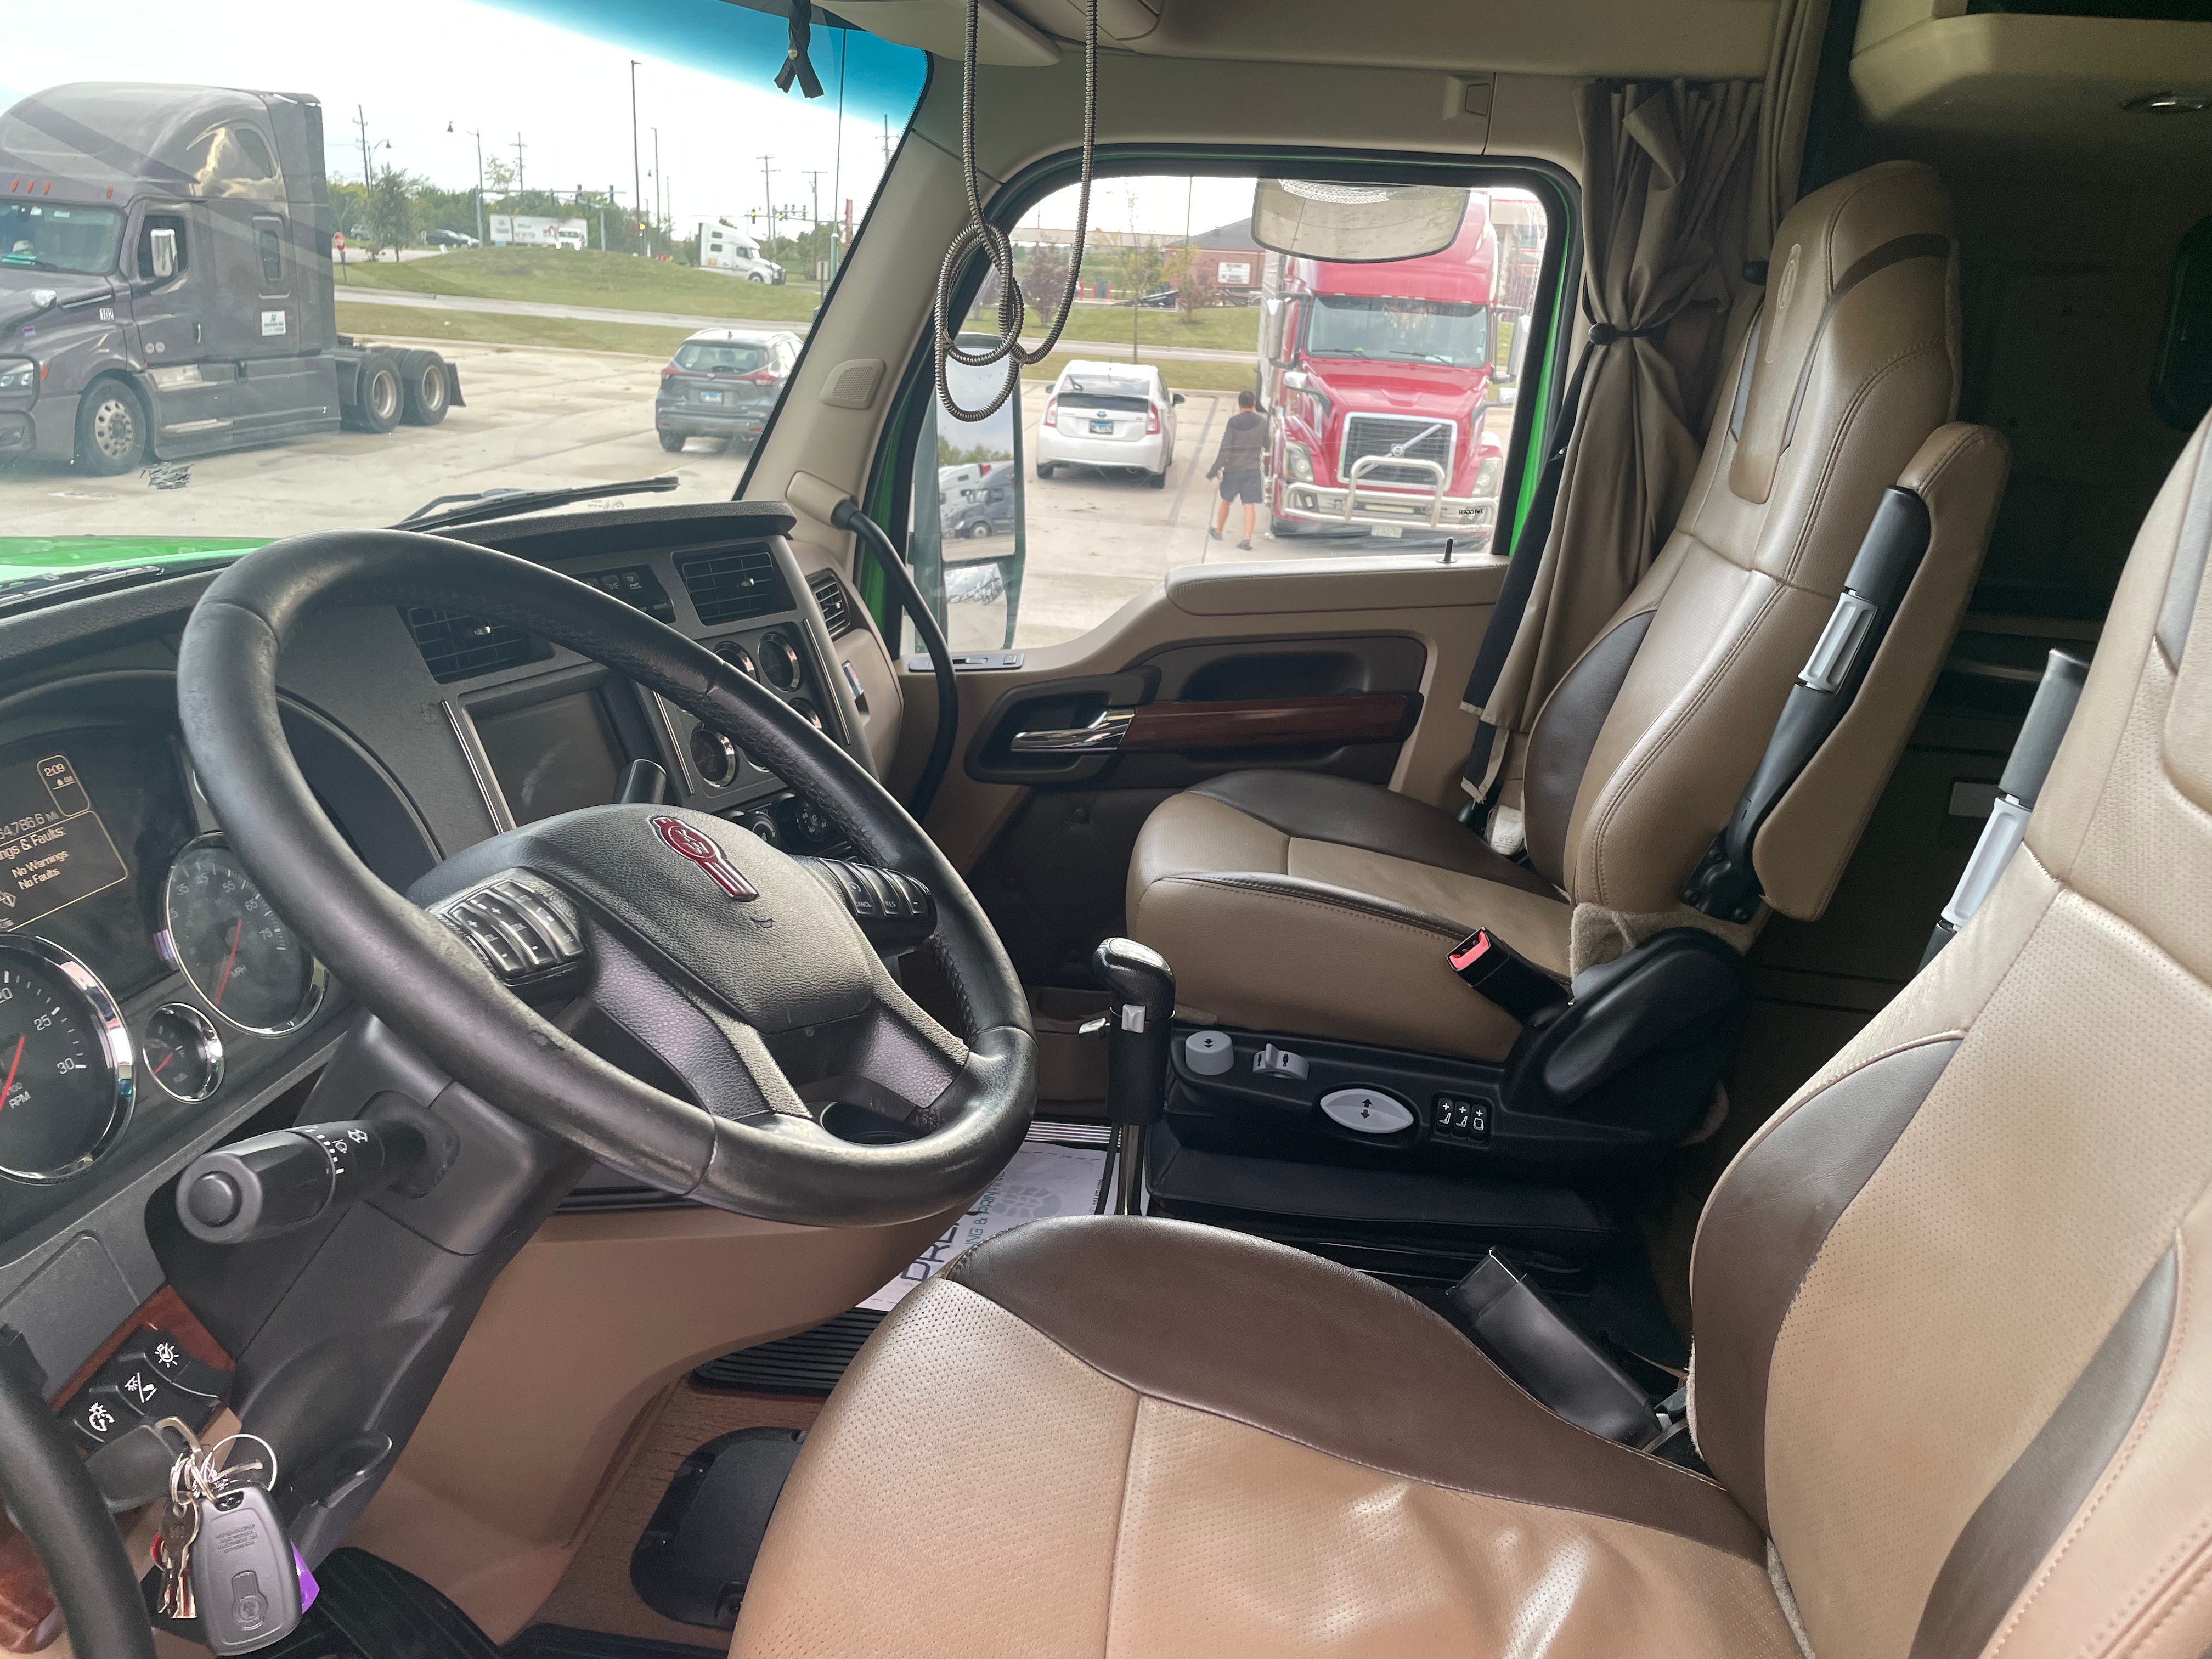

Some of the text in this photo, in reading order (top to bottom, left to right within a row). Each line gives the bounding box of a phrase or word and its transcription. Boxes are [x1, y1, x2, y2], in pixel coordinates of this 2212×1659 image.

[20, 838, 32, 851] &
[12, 850, 69, 878] No Warnings
[18, 867, 61, 890] No Faults
[222, 879, 236, 893] 55
[176, 883, 189, 896] 35
[33, 1014, 52, 1031] 25
[57, 1057, 75, 1075] 30
[8, 1091, 32, 1109] RPM
